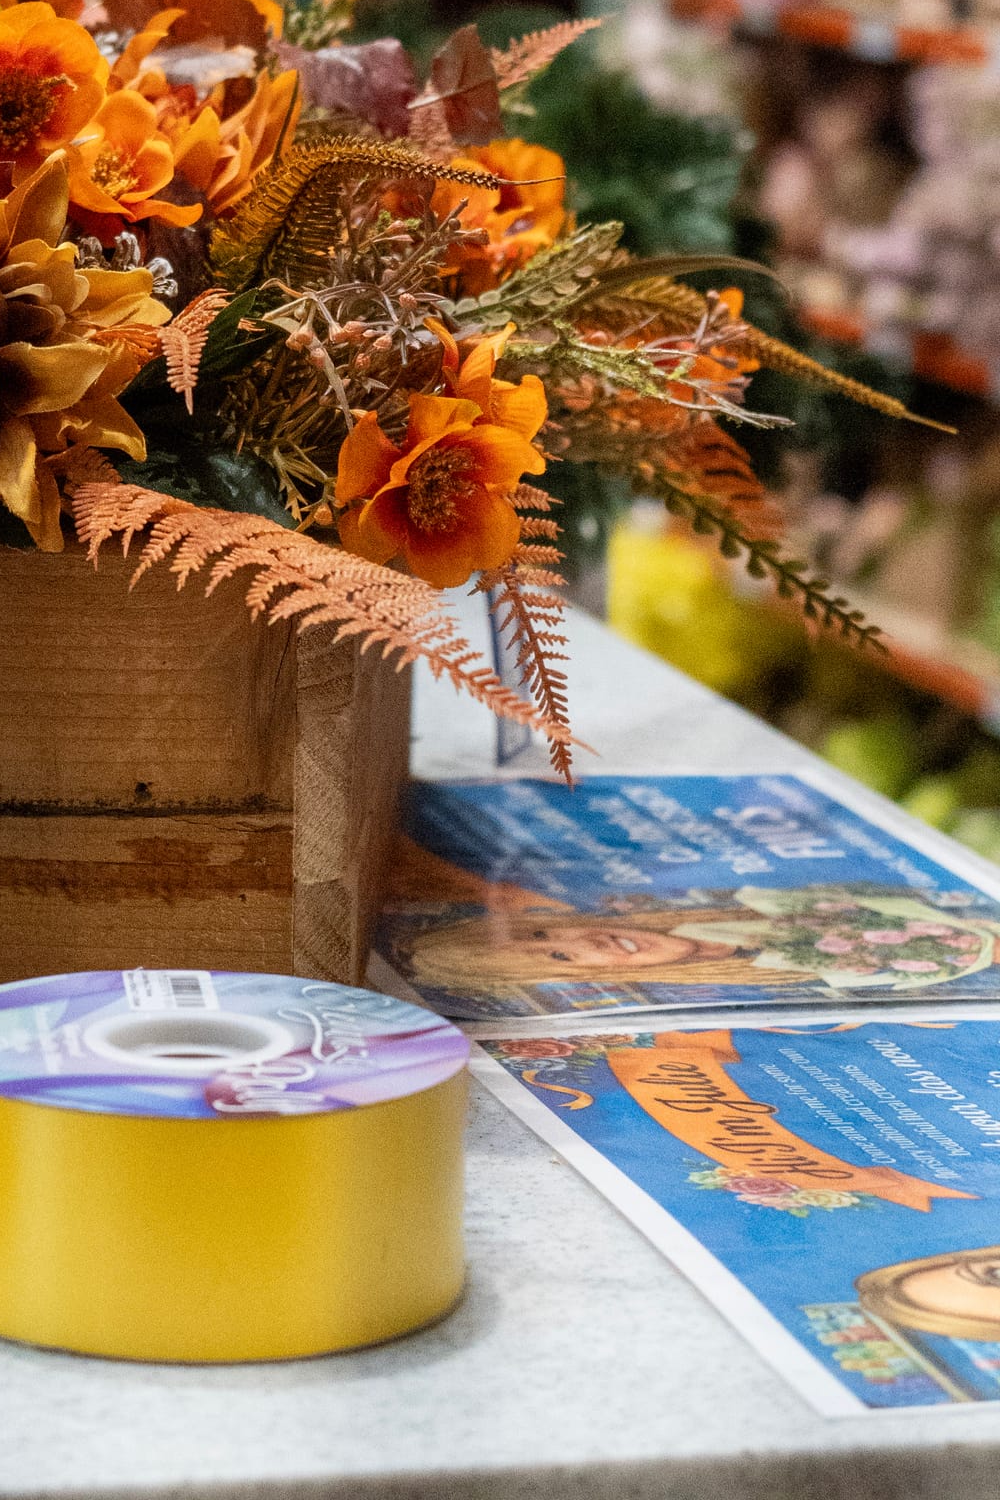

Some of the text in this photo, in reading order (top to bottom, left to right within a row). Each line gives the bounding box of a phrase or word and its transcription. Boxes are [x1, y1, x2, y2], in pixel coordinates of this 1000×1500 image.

[212, 1058, 325, 1115] Poly
[866, 1039, 922, 1068] now
[905, 1070, 966, 1100] class
[636, 1061, 854, 1179] Hi I'm Julie
[759, 1064, 896, 1164] Come and join me for some
[779, 1049, 963, 1179] floristry tuition and create your own
[839, 1065, 971, 1156] beautiful floral creations
